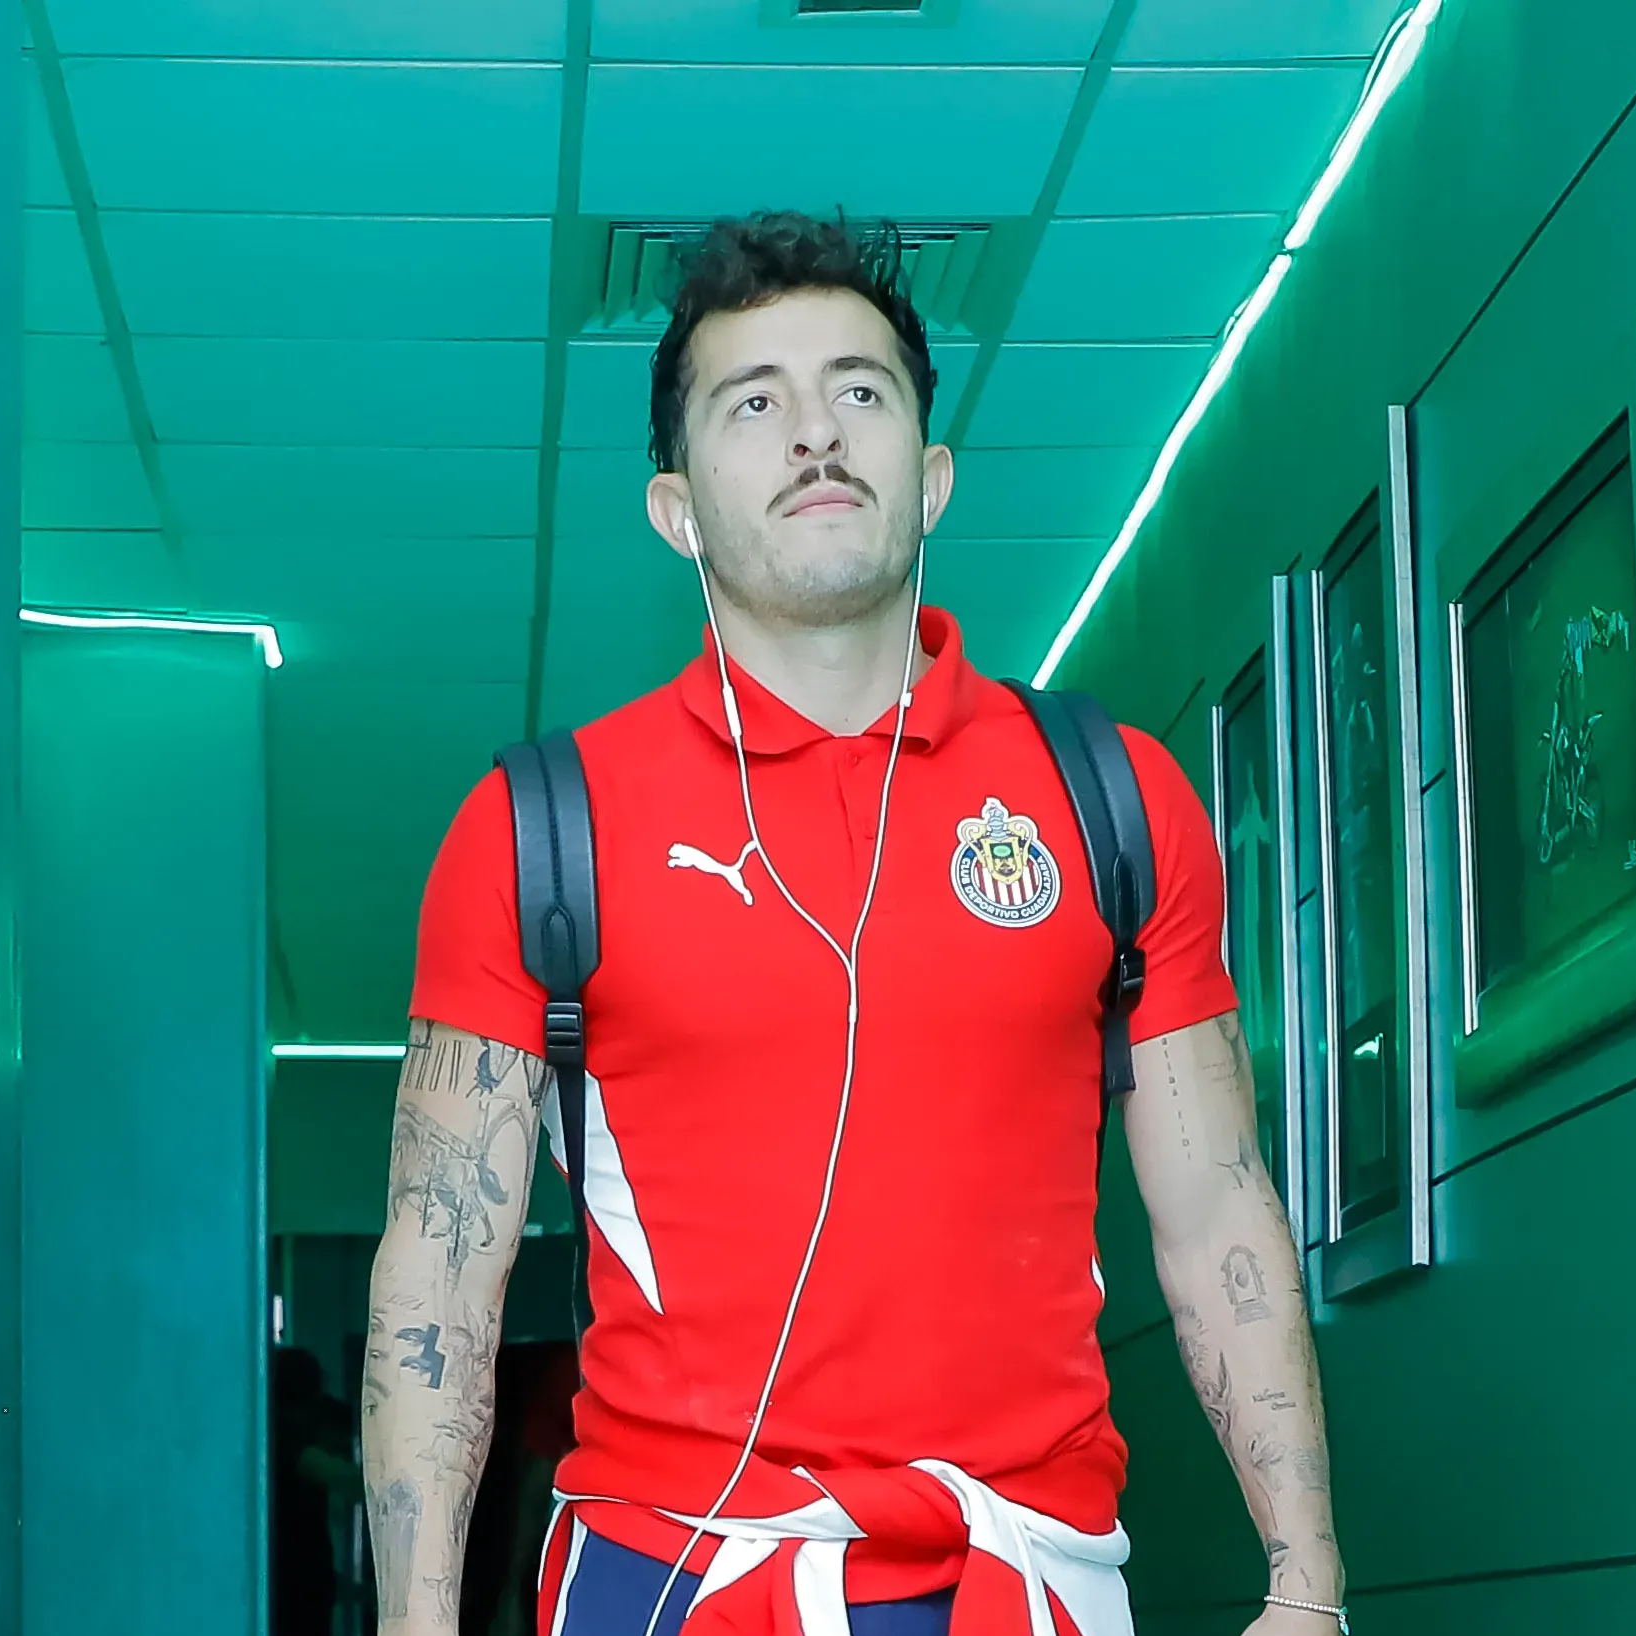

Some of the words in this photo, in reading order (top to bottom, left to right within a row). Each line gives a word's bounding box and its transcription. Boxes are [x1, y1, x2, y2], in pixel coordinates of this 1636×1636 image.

[960, 858, 971, 885] CLUB
[1020, 855, 1052, 918] GUADALAJARA
[965, 886, 1020, 919] DEPORTIVO
